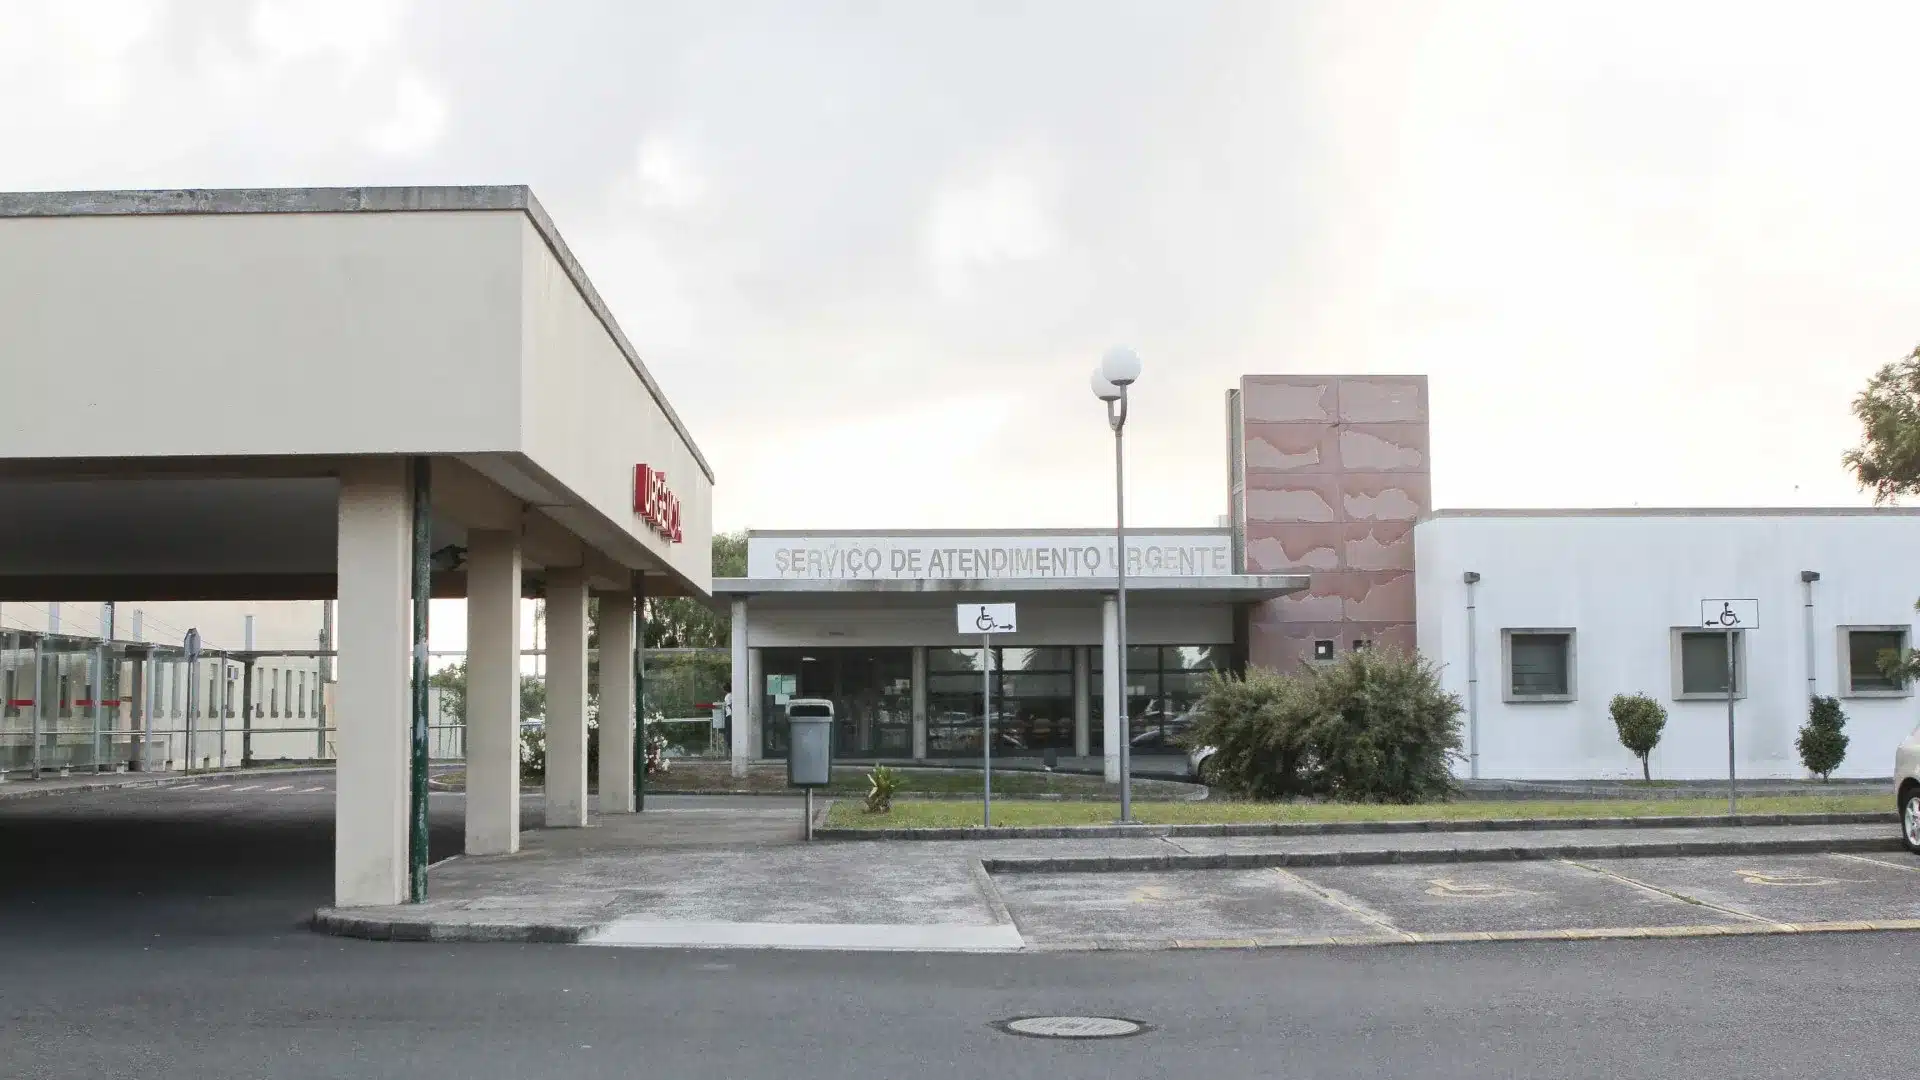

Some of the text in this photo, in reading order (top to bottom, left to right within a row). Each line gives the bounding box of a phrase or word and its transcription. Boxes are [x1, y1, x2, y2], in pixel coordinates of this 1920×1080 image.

[775, 546, 1226, 576] SERVIÇO DE ATENDIMENTO URGENTE
